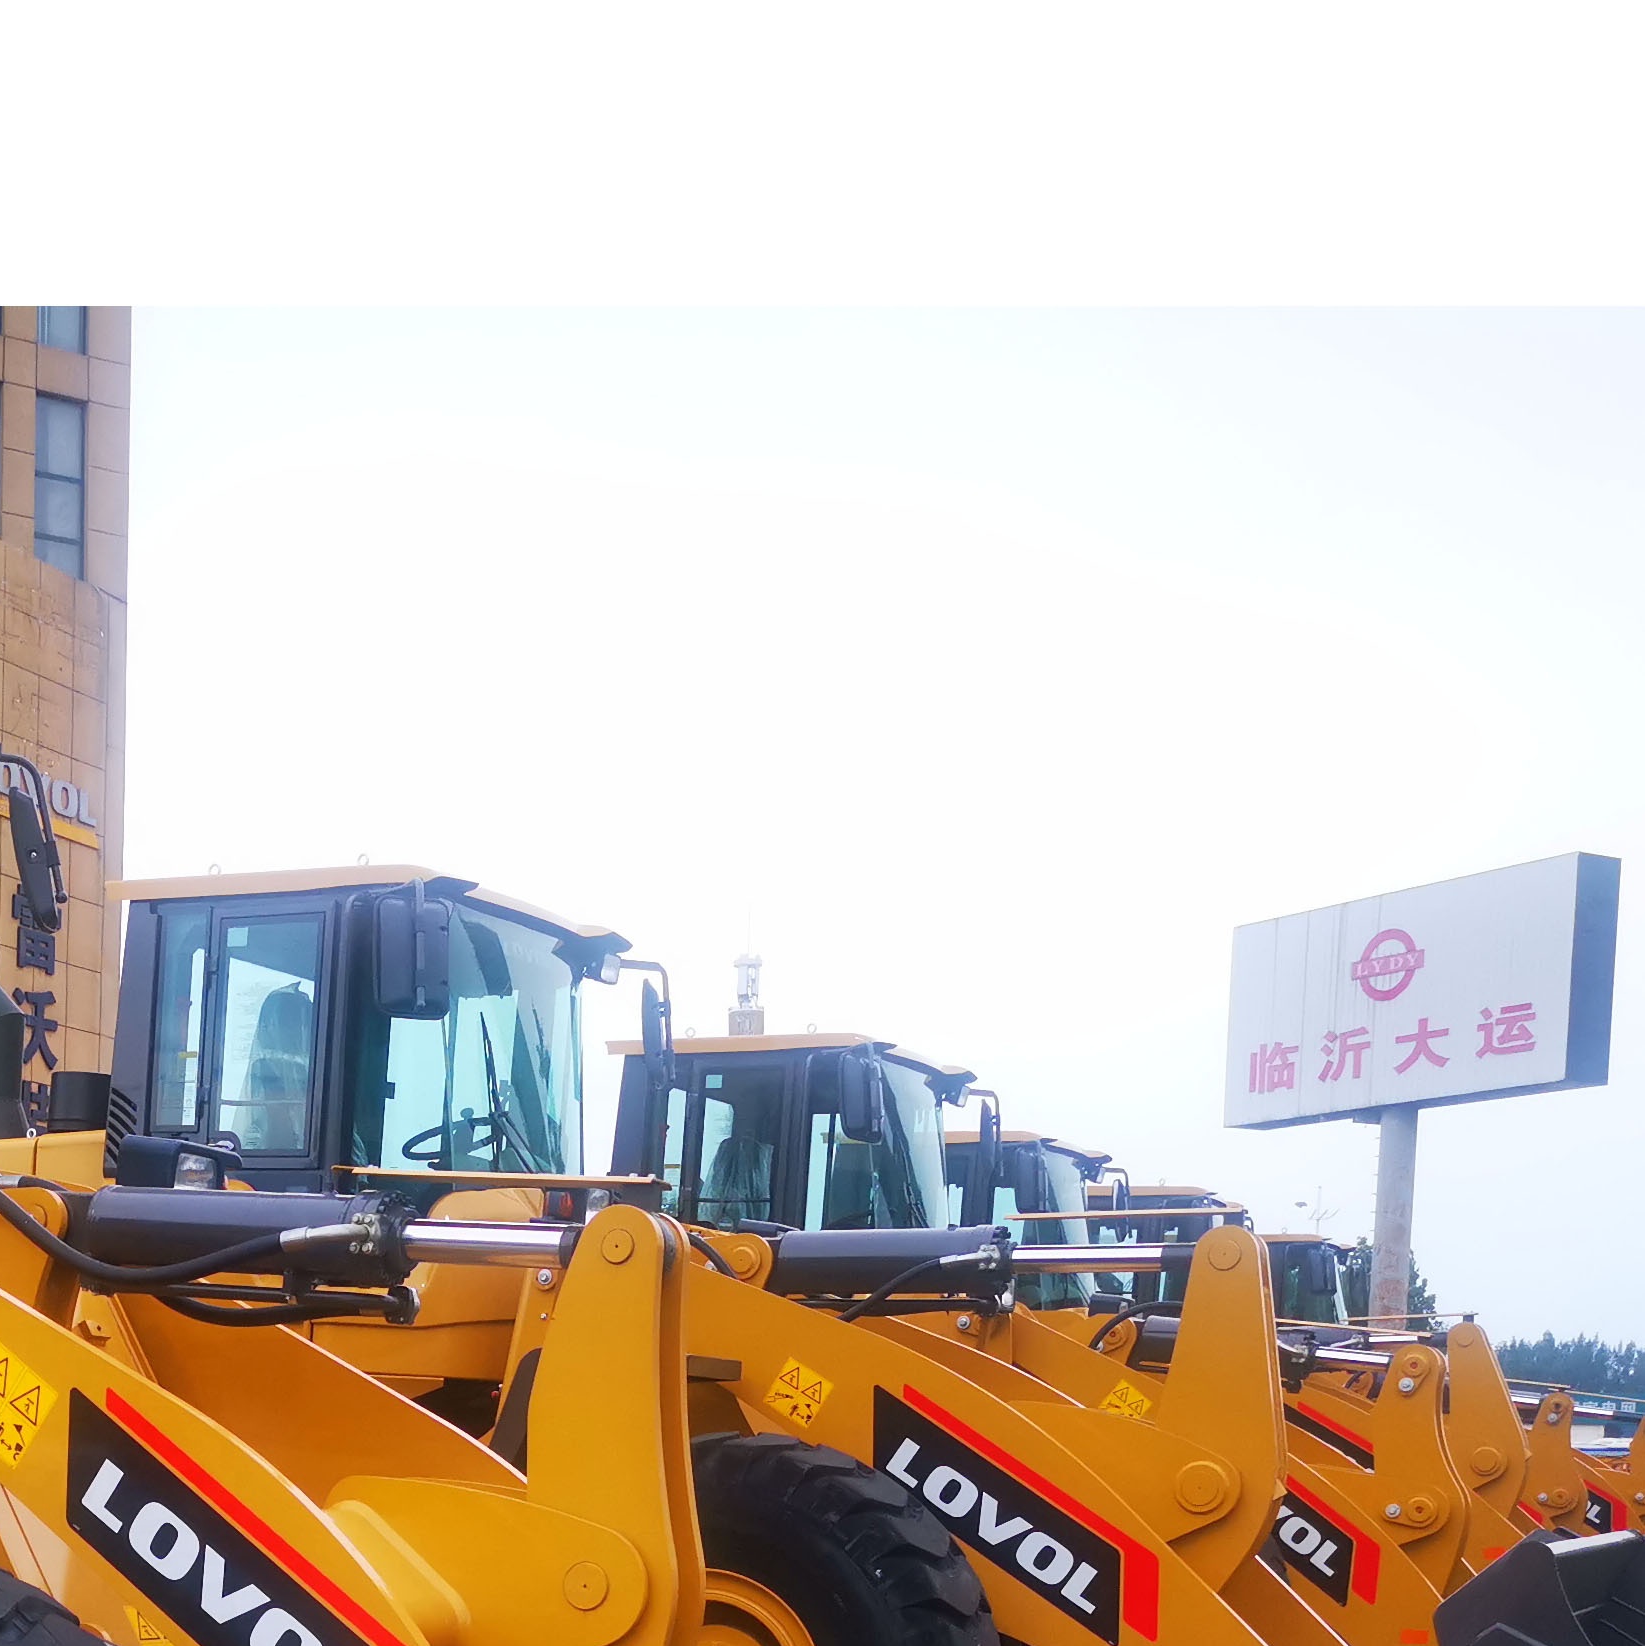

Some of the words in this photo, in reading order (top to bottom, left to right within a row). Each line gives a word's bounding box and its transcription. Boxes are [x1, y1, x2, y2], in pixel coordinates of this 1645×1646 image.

[1356, 951, 1420, 978] LYDY
[1248, 1001, 1537, 1095] 临沂大运
[885, 1437, 1099, 1615] LOVOL
